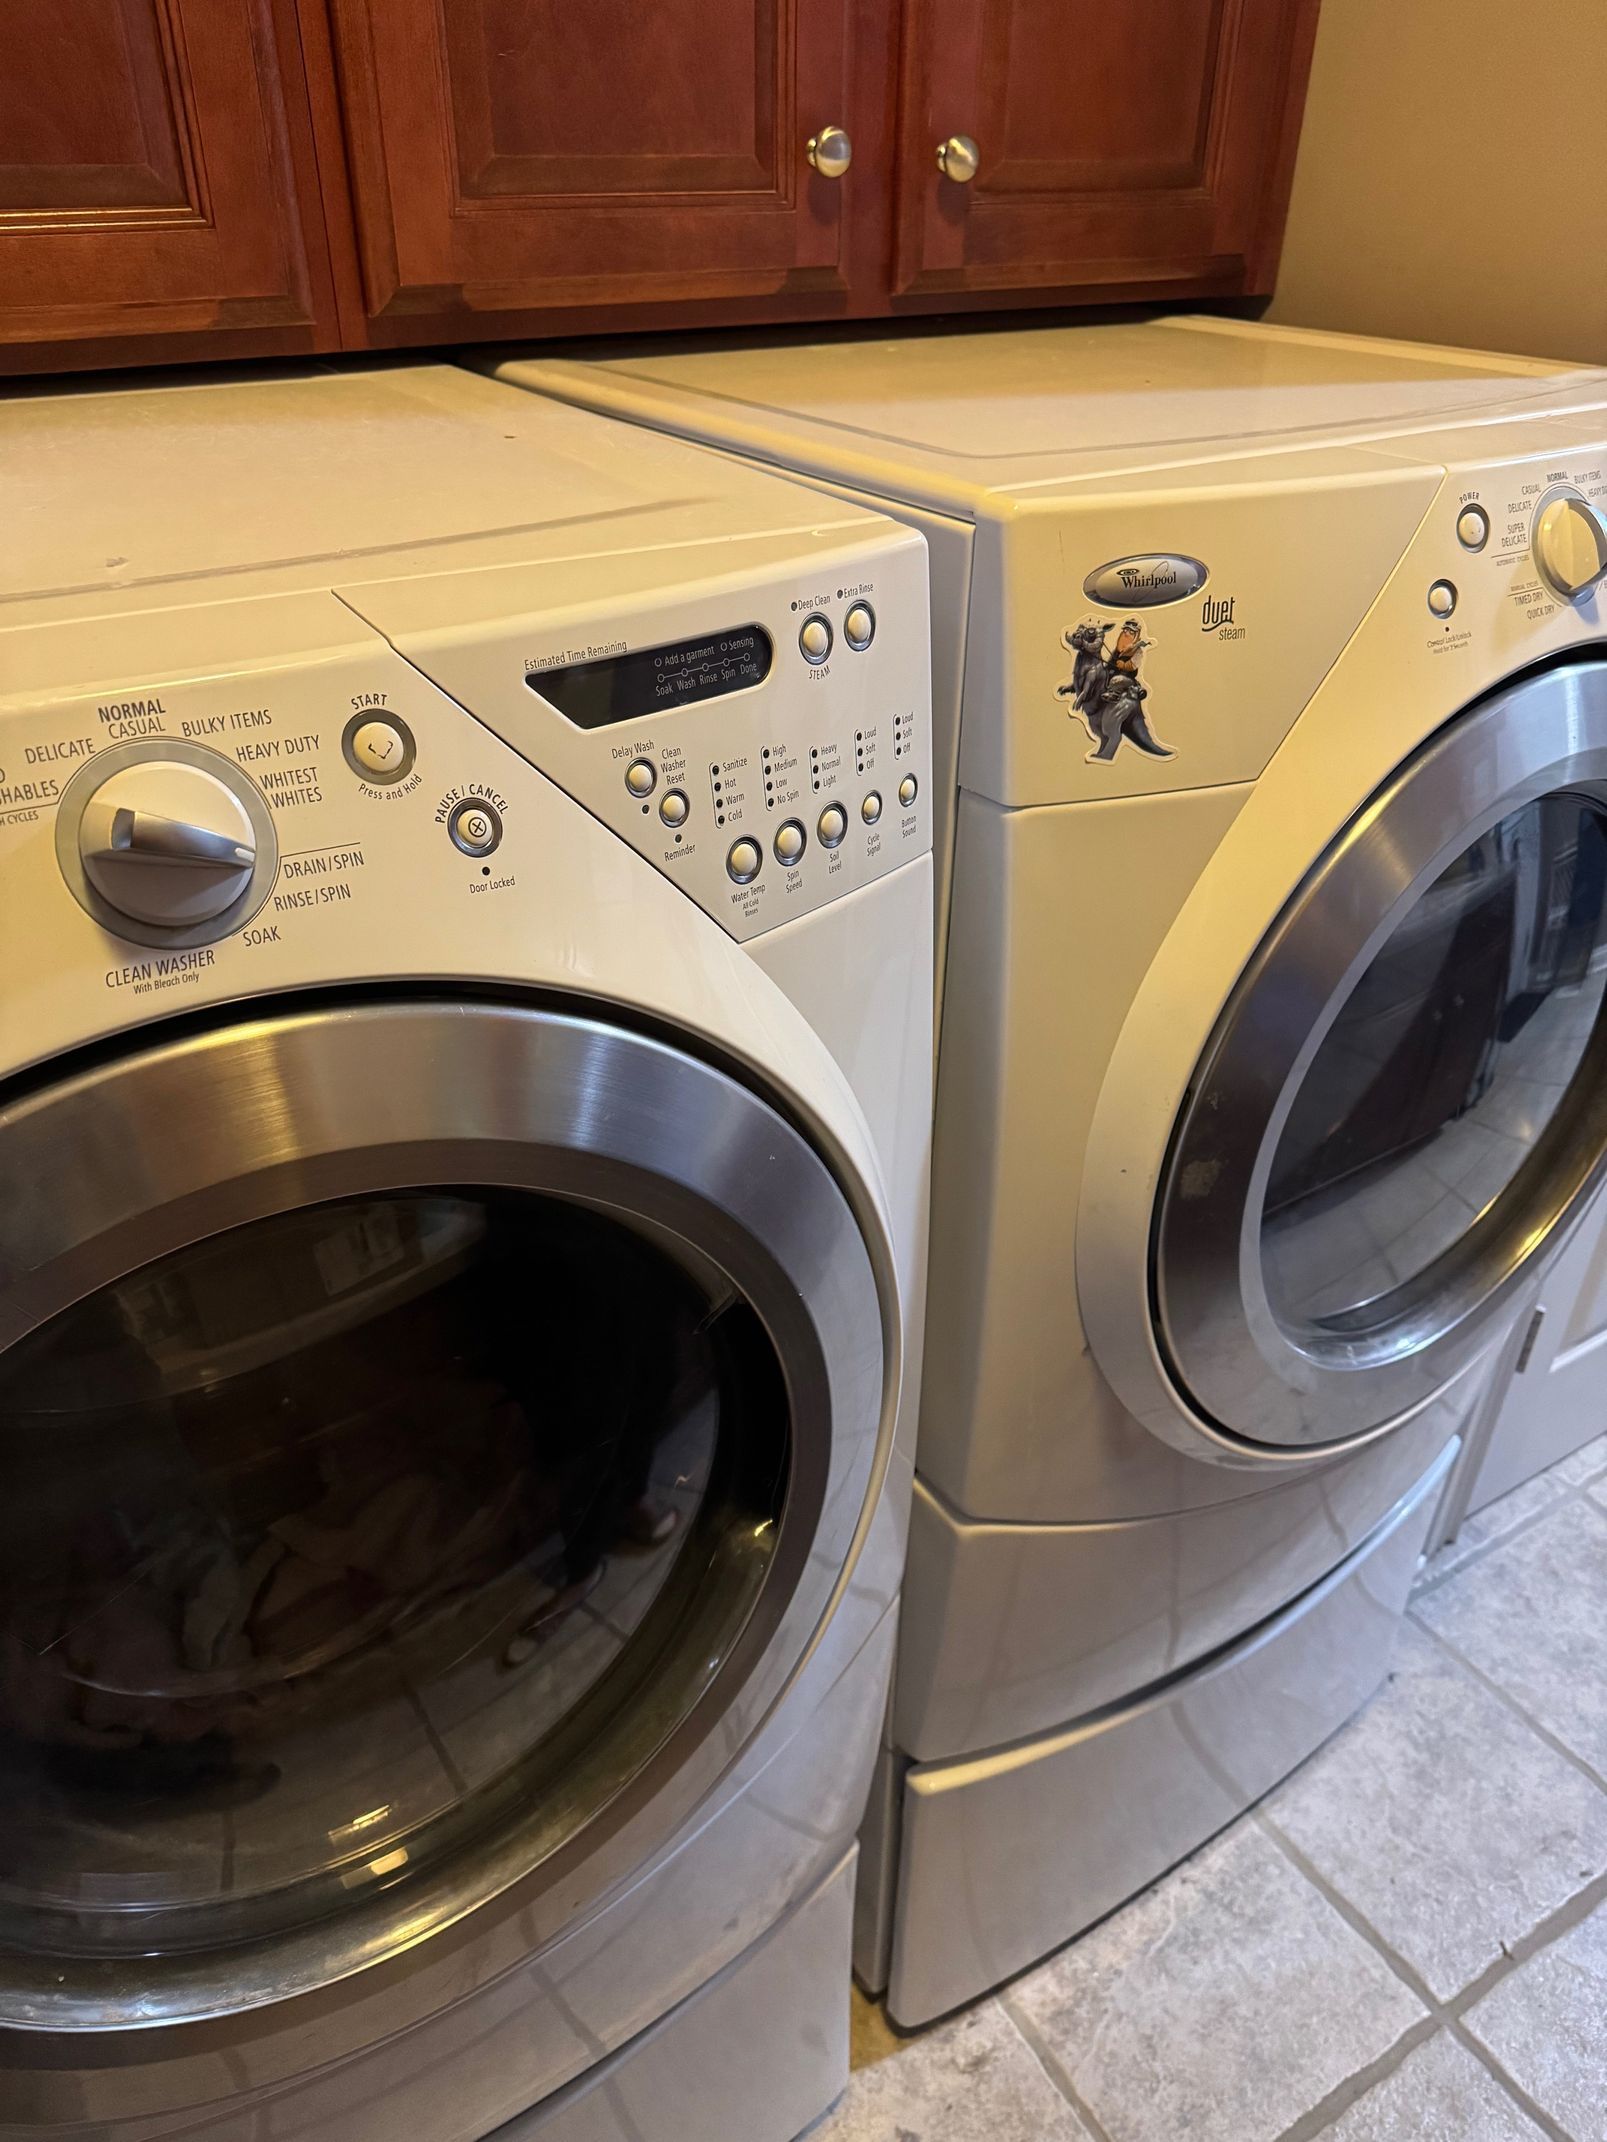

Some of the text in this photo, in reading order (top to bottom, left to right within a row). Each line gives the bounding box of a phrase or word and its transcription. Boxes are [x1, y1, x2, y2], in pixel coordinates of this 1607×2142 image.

[1459, 491, 1480, 504] POWER
[1521, 484, 1541, 495] CASUAL
[1507, 500, 1532, 513] DELICATE
[1507, 522, 1525, 534] SUPER
[1501, 533, 1527, 547] DELICATE
[1120, 571, 1177, 589] Whirlpool
[843, 583, 874, 599] Extra Rinse
[1514, 592, 1533, 606] TIMED
[798, 595, 831, 611] Deep Clean
[1202, 595, 1235, 629] duet
[1526, 604, 1555, 620] QUICK DRY
[1218, 626, 1246, 641] steam
[729, 637, 754, 651] Sensing
[524, 640, 628, 670] Estimated Time Remaining
[664, 645, 715, 666] Add a garment
[656, 662, 757, 697] Soak Wash Rinse Spin Done
[808, 664, 831, 680] STEAM
[351, 693, 387, 710] START
[98, 698, 167, 723] NORMAL
[901, 711, 914, 724] Loud
[108, 716, 166, 739] CASUAL
[181, 709, 273, 737] BULKY ITEMS
[864, 725, 877, 740] Loud
[902, 727, 913, 739] Soft
[25, 738, 96, 764] DELICATE
[236, 734, 320, 762] HEAVY DUTY
[611, 739, 655, 759] Delay Wash
[661, 746, 682, 760] Clean
[772, 744, 787, 757] High
[820, 743, 837, 756] Heavy
[865, 743, 876, 755] Soft
[660, 759, 686, 773] Washer
[722, 757, 748, 772] Sanitize
[774, 757, 798, 773] Medium
[821, 756, 841, 772] Normal
[866, 757, 875, 770] Off
[259, 767, 318, 790] WHITEST
[358, 773, 423, 800] Press and Hold
[666, 772, 686, 785] Reset
[724, 778, 737, 789] Hot
[775, 778, 788, 789] Low
[822, 774, 837, 788] Light
[0, 779, 59, 805] HABLES
[271, 786, 323, 809] WHITES
[725, 792, 745, 806] Warm
[777, 789, 800, 805] No Spin
[7, 810, 39, 825] CYCLES
[728, 808, 743, 822] Cold
[867, 833, 880, 846] Cycle
[902, 825, 917, 839] Sound
[664, 843, 696, 861] Reminder
[829, 851, 840, 863] Soil
[866, 842, 881, 857] Signal
[283, 851, 365, 879] DRAIN/SPIN
[828, 861, 842, 874] Level
[469, 875, 516, 894] Door Locked
[787, 870, 799, 883] Spin
[731, 883, 766, 904] Water Temp
[785, 878, 803, 894] Speed
[274, 883, 351, 912] RINSE/SPIN
[242, 925, 282, 947] SOAK
[105, 949, 215, 988] CLEAN WASHER
[133, 970, 200, 995] With Bleach Only
